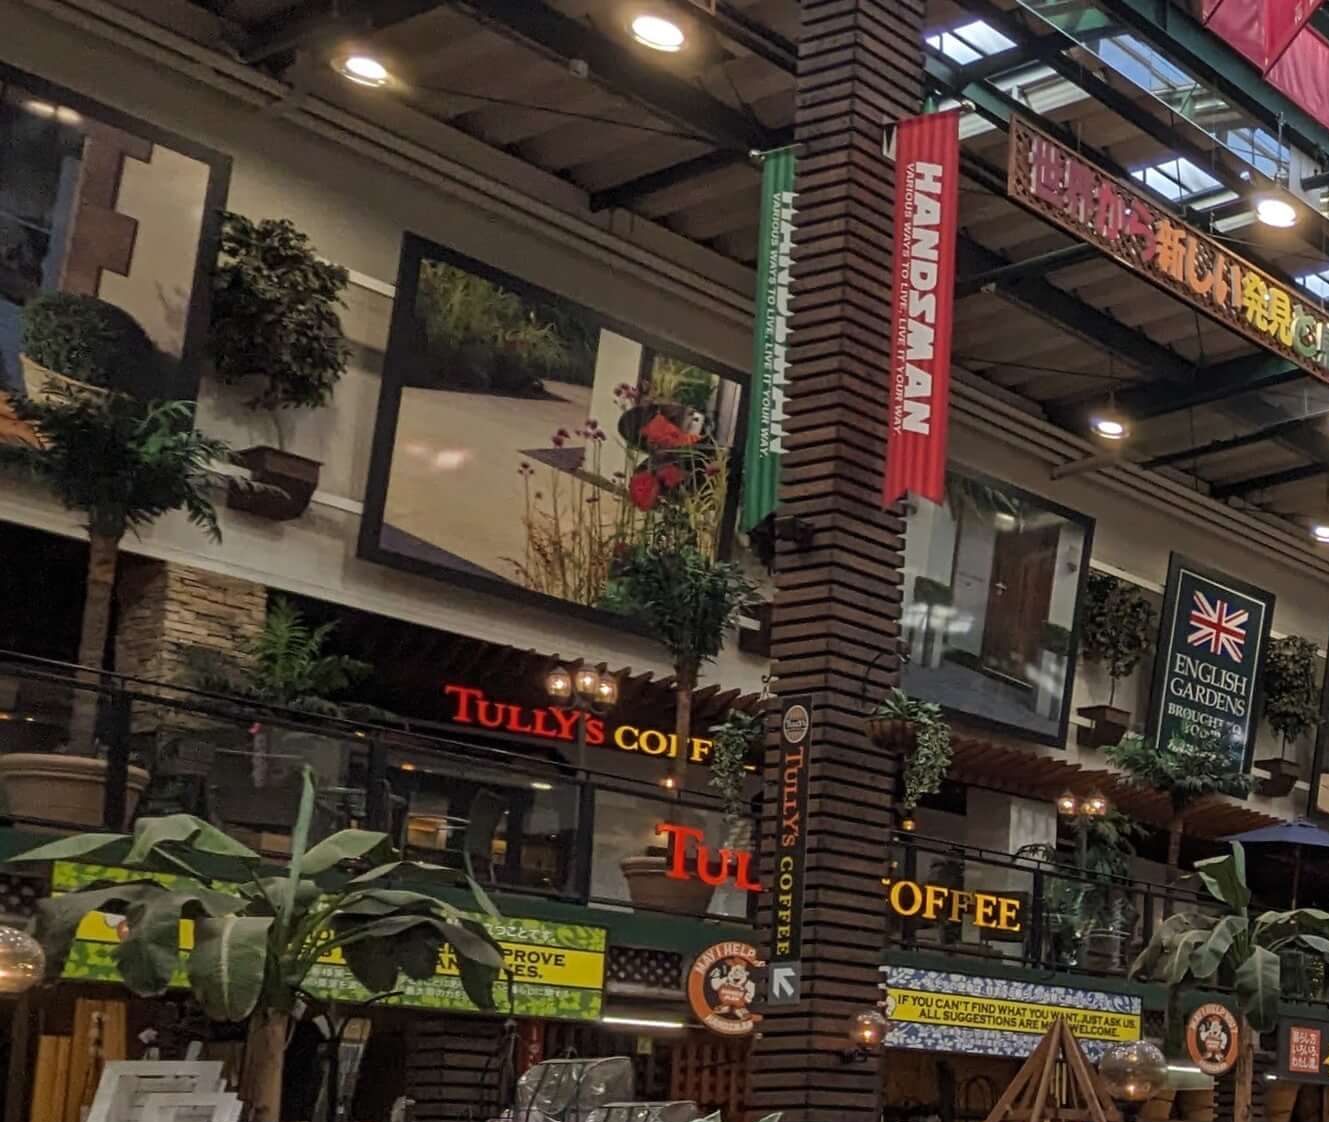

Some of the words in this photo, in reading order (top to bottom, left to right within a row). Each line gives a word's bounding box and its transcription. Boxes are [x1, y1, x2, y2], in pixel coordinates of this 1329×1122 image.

[902, 160, 943, 435] HANDSMAN
[1175, 653, 1247, 696] ENGLISH
[1170, 678, 1245, 717] GARDENS
[776, 856, 793, 955] COFFEE
[882, 878, 1021, 931] OFFEE
[898, 995, 909, 1005] IF
[912, 996, 933, 1008] YOU
[936, 998, 970, 1012] CAN'T
[971, 1001, 995, 1013] FIND
[997, 1003, 1027, 1016] WHAT
[1029, 1006, 1048, 1018] YOU
[1080, 1013, 1102, 1025] JUST
[1103, 1015, 1122, 1027] ASK
[919, 1009, 937, 1022] ALL
[939, 1011, 1016, 1029] SUGGESTIONS
[1018, 1016, 1039, 1029] ARE
